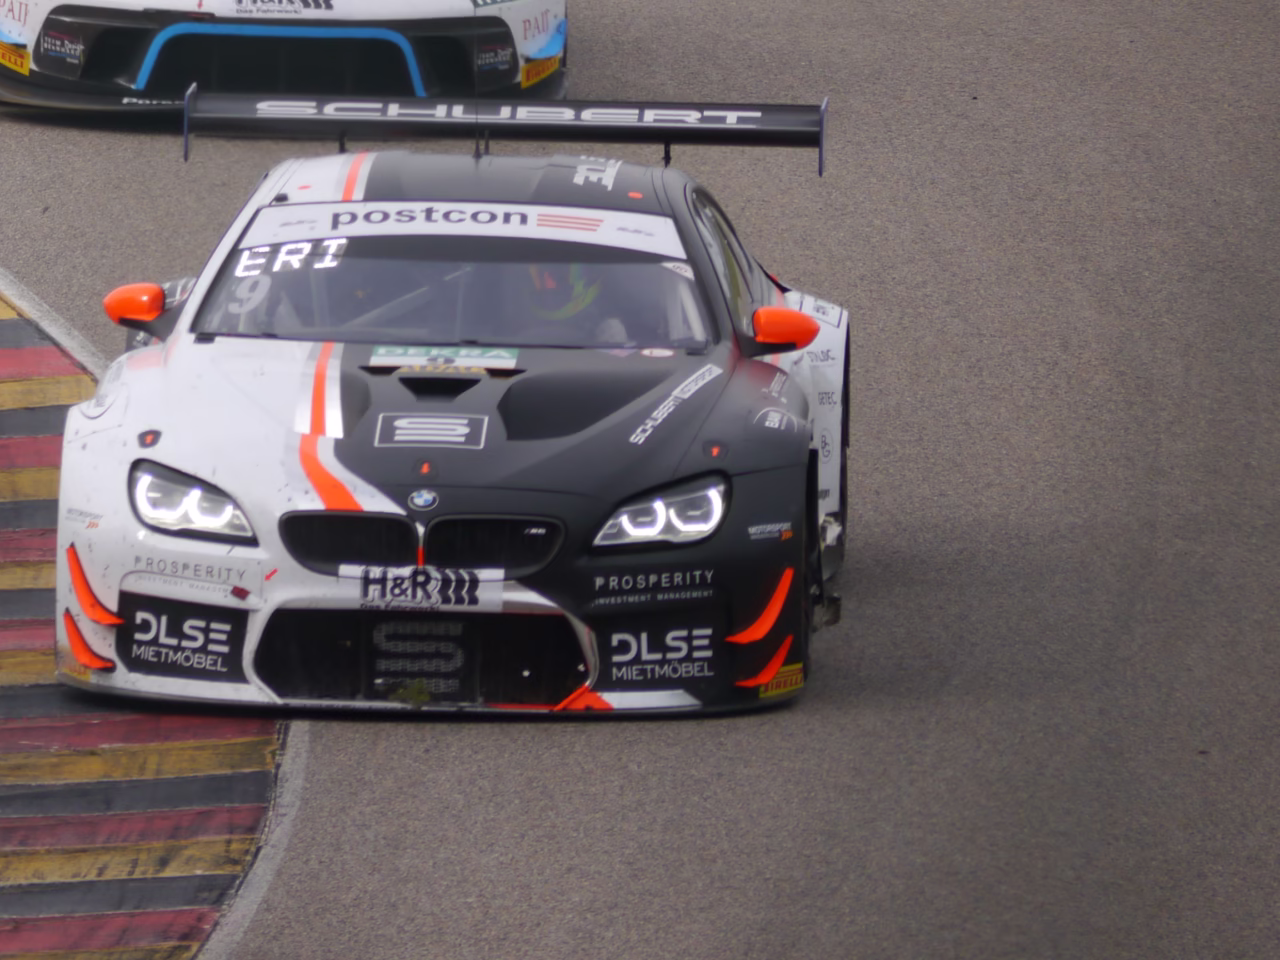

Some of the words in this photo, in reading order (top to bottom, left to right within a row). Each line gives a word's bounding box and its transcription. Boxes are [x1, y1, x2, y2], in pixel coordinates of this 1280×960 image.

[256, 100, 762, 125] SCHUBERT
[331, 207, 528, 231] postcon
[234, 238, 347, 277] ERI
[228, 275, 272, 314] 9
[134, 555, 247, 582] PROSPERITY
[594, 569, 714, 591] PROSPERITY
[361, 567, 434, 604] H&R
[594, 594, 651, 606] INVESTMENT
[656, 590, 713, 601] MANAGEMENT
[134, 611, 232, 653] DLSE
[611, 628, 713, 663] DLSE
[131, 643, 228, 672] MIETMÖBEL
[612, 659, 715, 682] MIETMÖBEL
